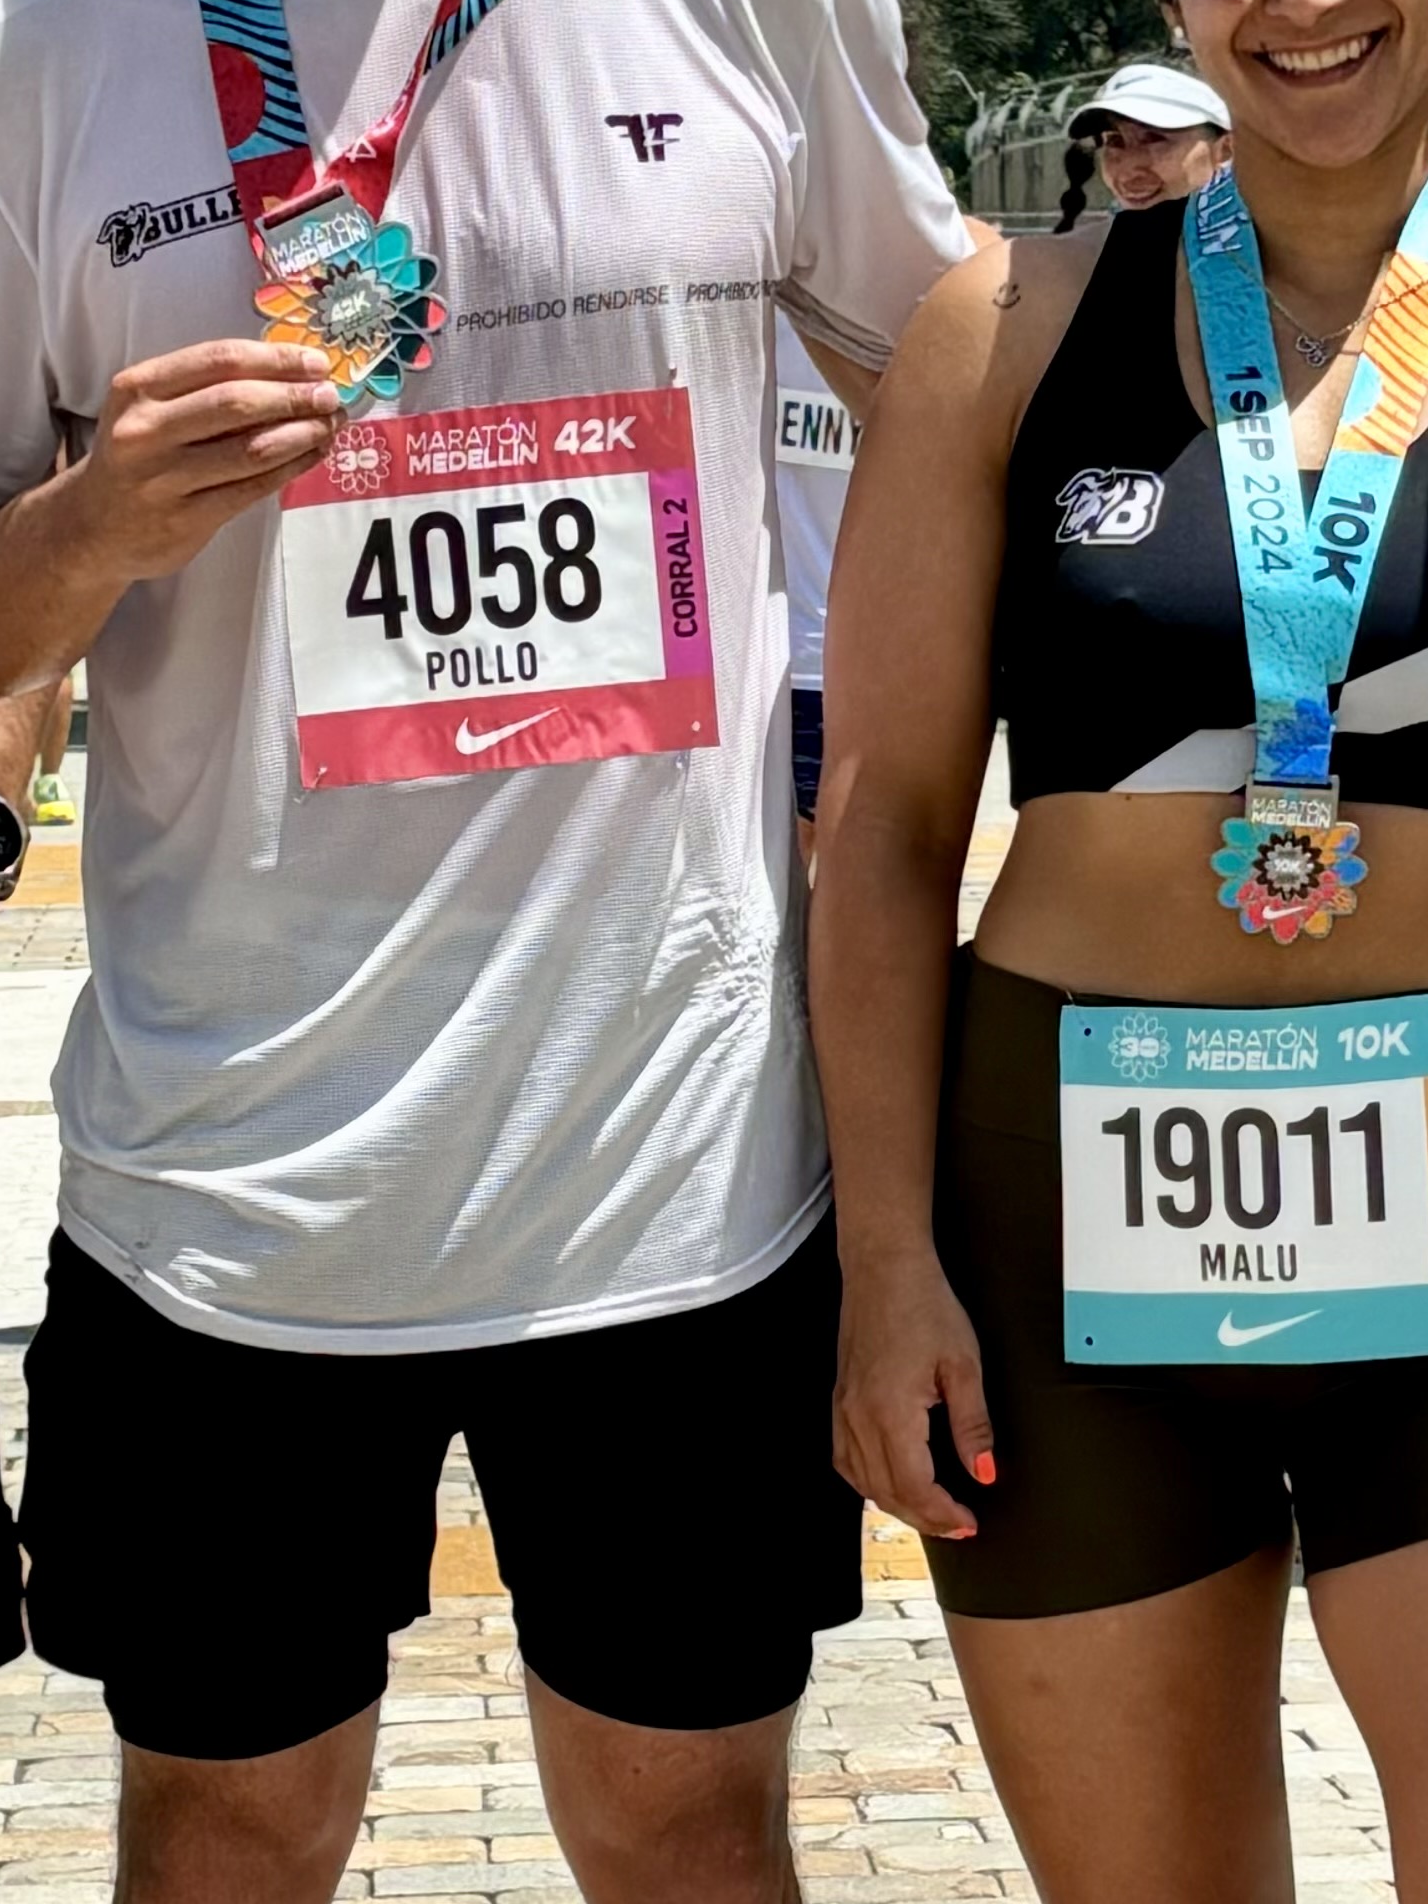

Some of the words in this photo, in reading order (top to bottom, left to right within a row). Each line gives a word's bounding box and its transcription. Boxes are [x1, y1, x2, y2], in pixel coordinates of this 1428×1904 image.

[457, 300, 567, 332] PROHIBIDO
[1225, 365, 1262, 381] 1
[406, 417, 536, 455] MARATÓN
[554, 415, 637, 456] 42K
[1229, 390, 1275, 462] SEP
[408, 443, 539, 476] MEDELLÍN
[663, 498, 688, 515] 2
[1243, 474, 1293, 575] 2024
[1312, 491, 1377, 595] 10K
[345, 497, 603, 641] 4058
[666, 526, 699, 638] CORRAL
[425, 642, 539, 690] POLLO
[1185, 1022, 1318, 1050] MARATÓN
[1337, 1021, 1411, 1061] 10K
[1186, 1045, 1320, 1071] MEDELLÍN
[1101, 1101, 1388, 1230] 19011
[1200, 1243, 1299, 1282] MALU
